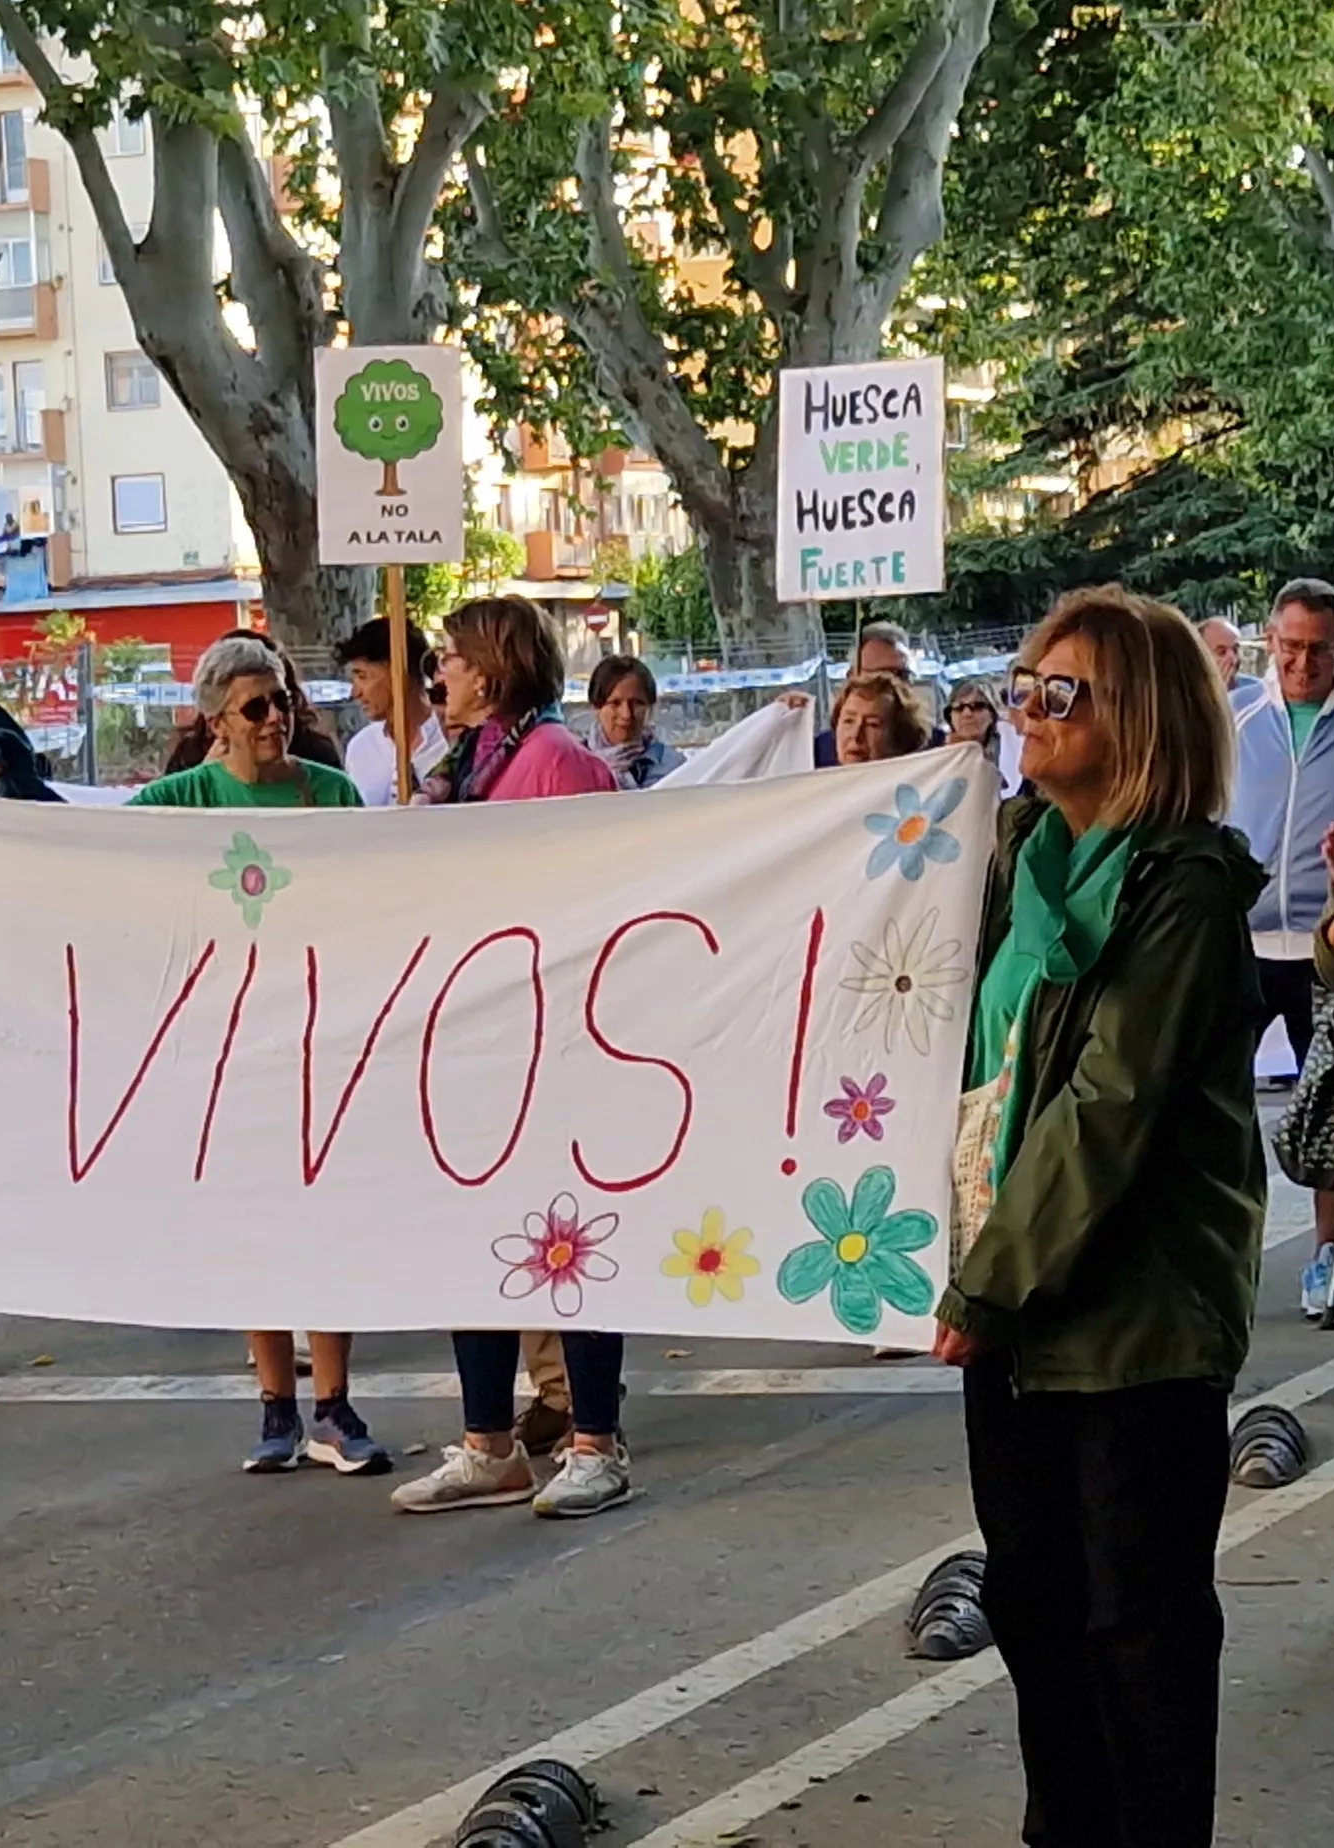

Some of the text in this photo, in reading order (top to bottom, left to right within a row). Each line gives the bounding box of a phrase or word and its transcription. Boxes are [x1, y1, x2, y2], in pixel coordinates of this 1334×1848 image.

[360, 381, 421, 402] VIVOS
[804, 380, 922, 434] HUESCA
[819, 431, 921, 474] VERDE,
[381, 504, 409, 518] NO
[796, 488, 916, 534] HUESCA
[347, 530, 443, 544] A LA TALA
[800, 547, 906, 592] FUERTE
